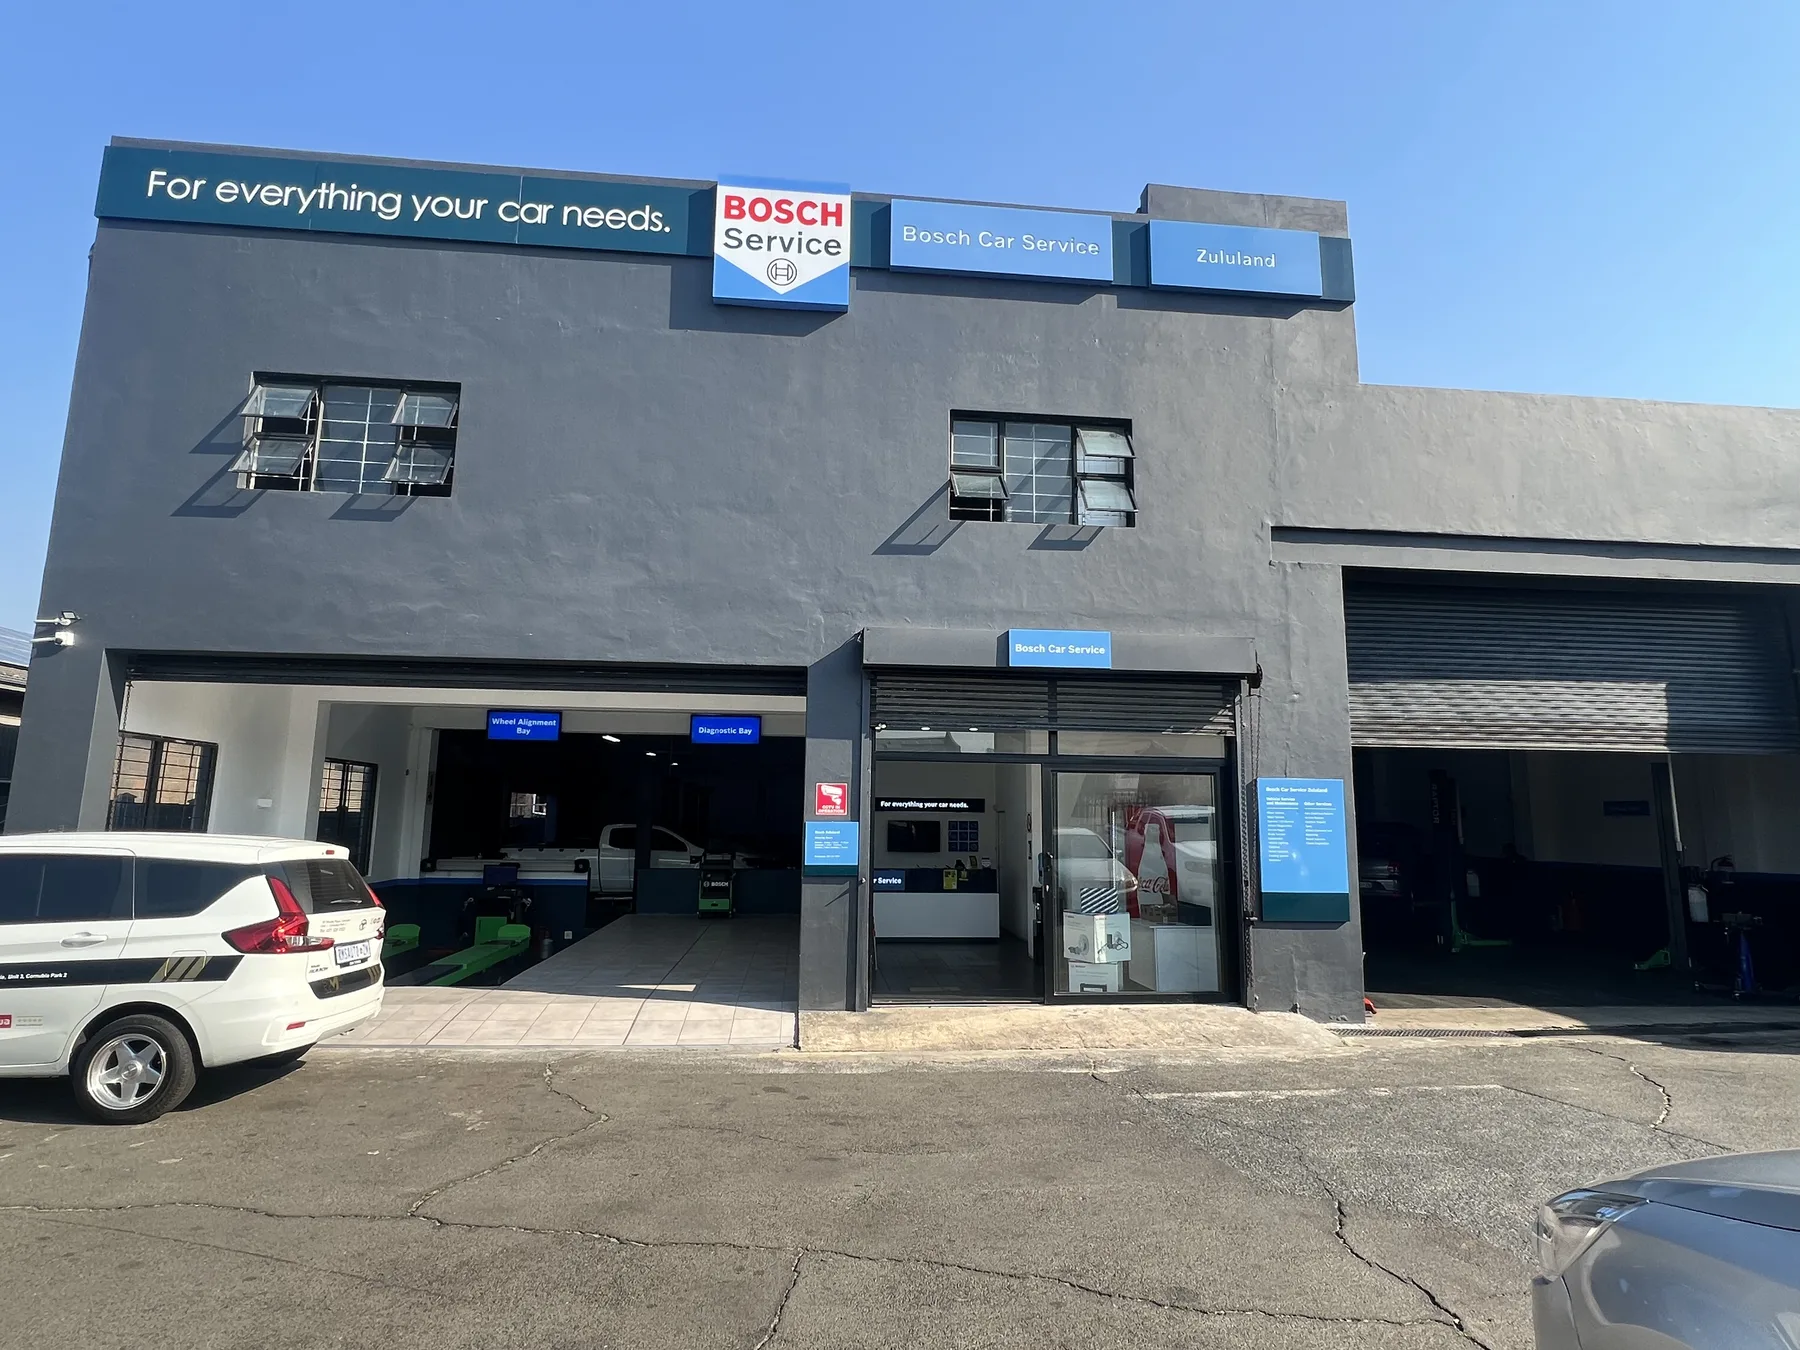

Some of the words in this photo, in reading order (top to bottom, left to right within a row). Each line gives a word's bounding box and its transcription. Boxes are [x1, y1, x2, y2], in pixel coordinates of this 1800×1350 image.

[147, 170, 206, 200] For
[215, 180, 402, 220] everything
[412, 194, 489, 221] your
[498, 200, 554, 225] car
[562, 204, 671, 233] needs.
[724, 195, 843, 227] BOSCH
[723, 227, 842, 256] Service
[903, 225, 970, 246] Bosch
[978, 231, 1015, 249] Car
[1022, 234, 1100, 255] Service
[1196, 249, 1276, 268] Zululand
[1015, 643, 1045, 653] Bosch
[1048, 644, 1066, 653] Car
[1068, 645, 1105, 654] Service
[516, 727, 531, 735] Bay
[518, 718, 557, 727] Alignment
[698, 727, 737, 735] Diagnostic
[738, 727, 752, 736] Bay
